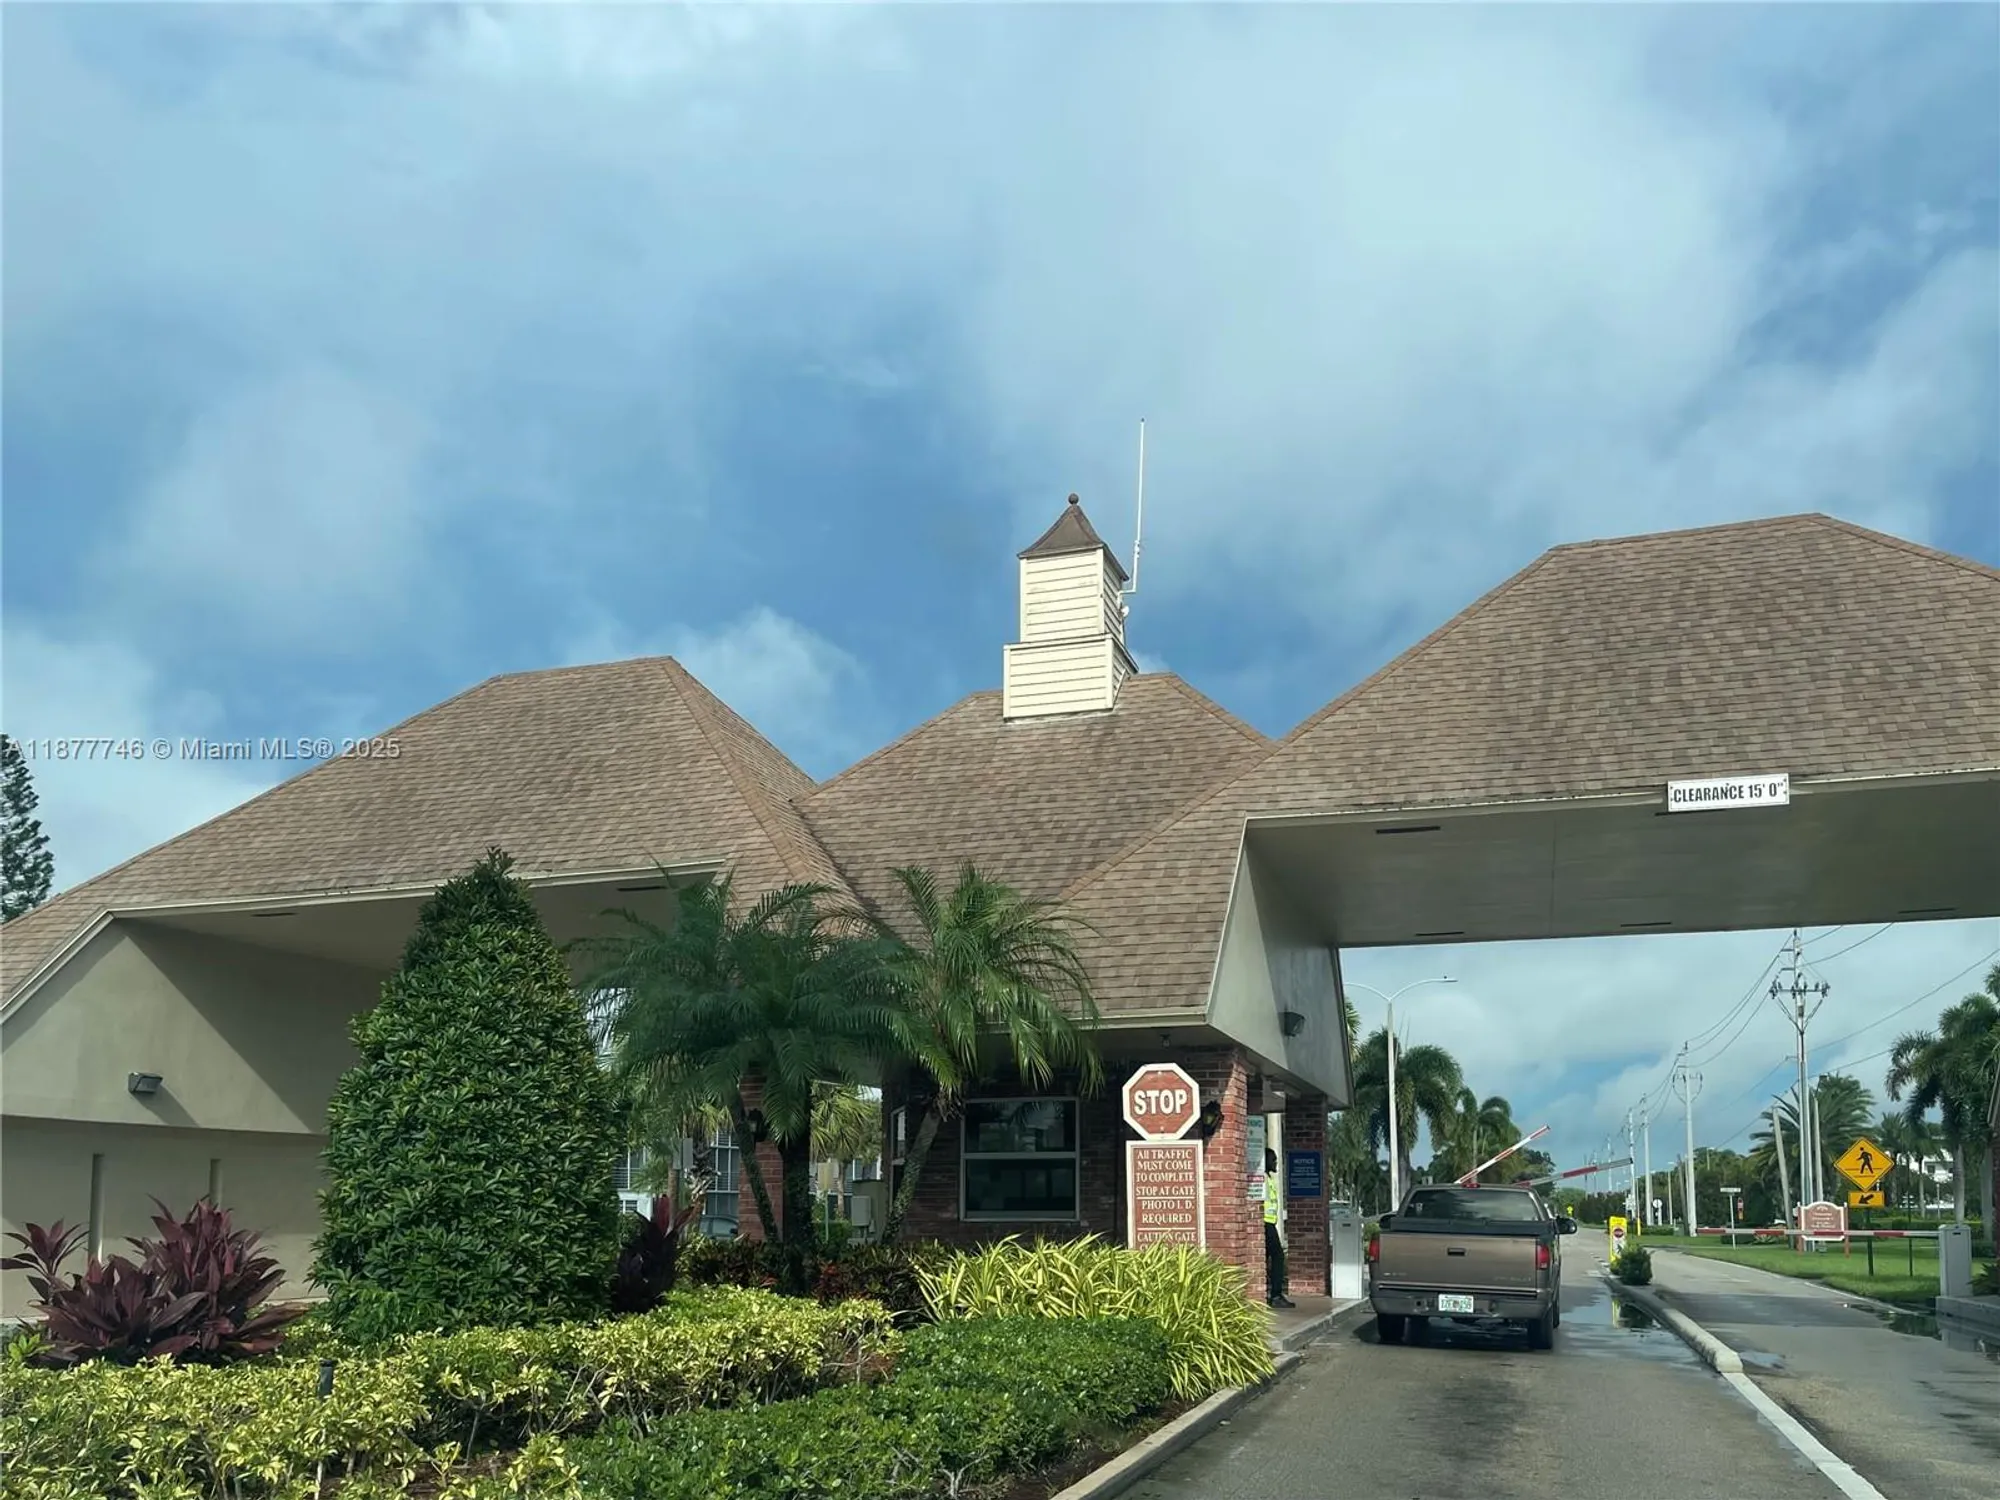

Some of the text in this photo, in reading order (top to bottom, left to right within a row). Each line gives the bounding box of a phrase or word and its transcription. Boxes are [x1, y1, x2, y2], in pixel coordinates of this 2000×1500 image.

[1673, 785, 1745, 803] CLEARANCE
[1134, 1088, 1188, 1115] STOP
[1151, 1149, 1193, 1160] TRAFFIC
[1137, 1160, 1194, 1170] MUST COME
[1136, 1172, 1195, 1182] TO COMPLETE
[1136, 1185, 1196, 1196] STOP AT GATE
[1142, 1200, 1175, 1210] PHOTO
[1142, 1213, 1192, 1225] REQUIRED
[1174, 1231, 1197, 1242] GATE
